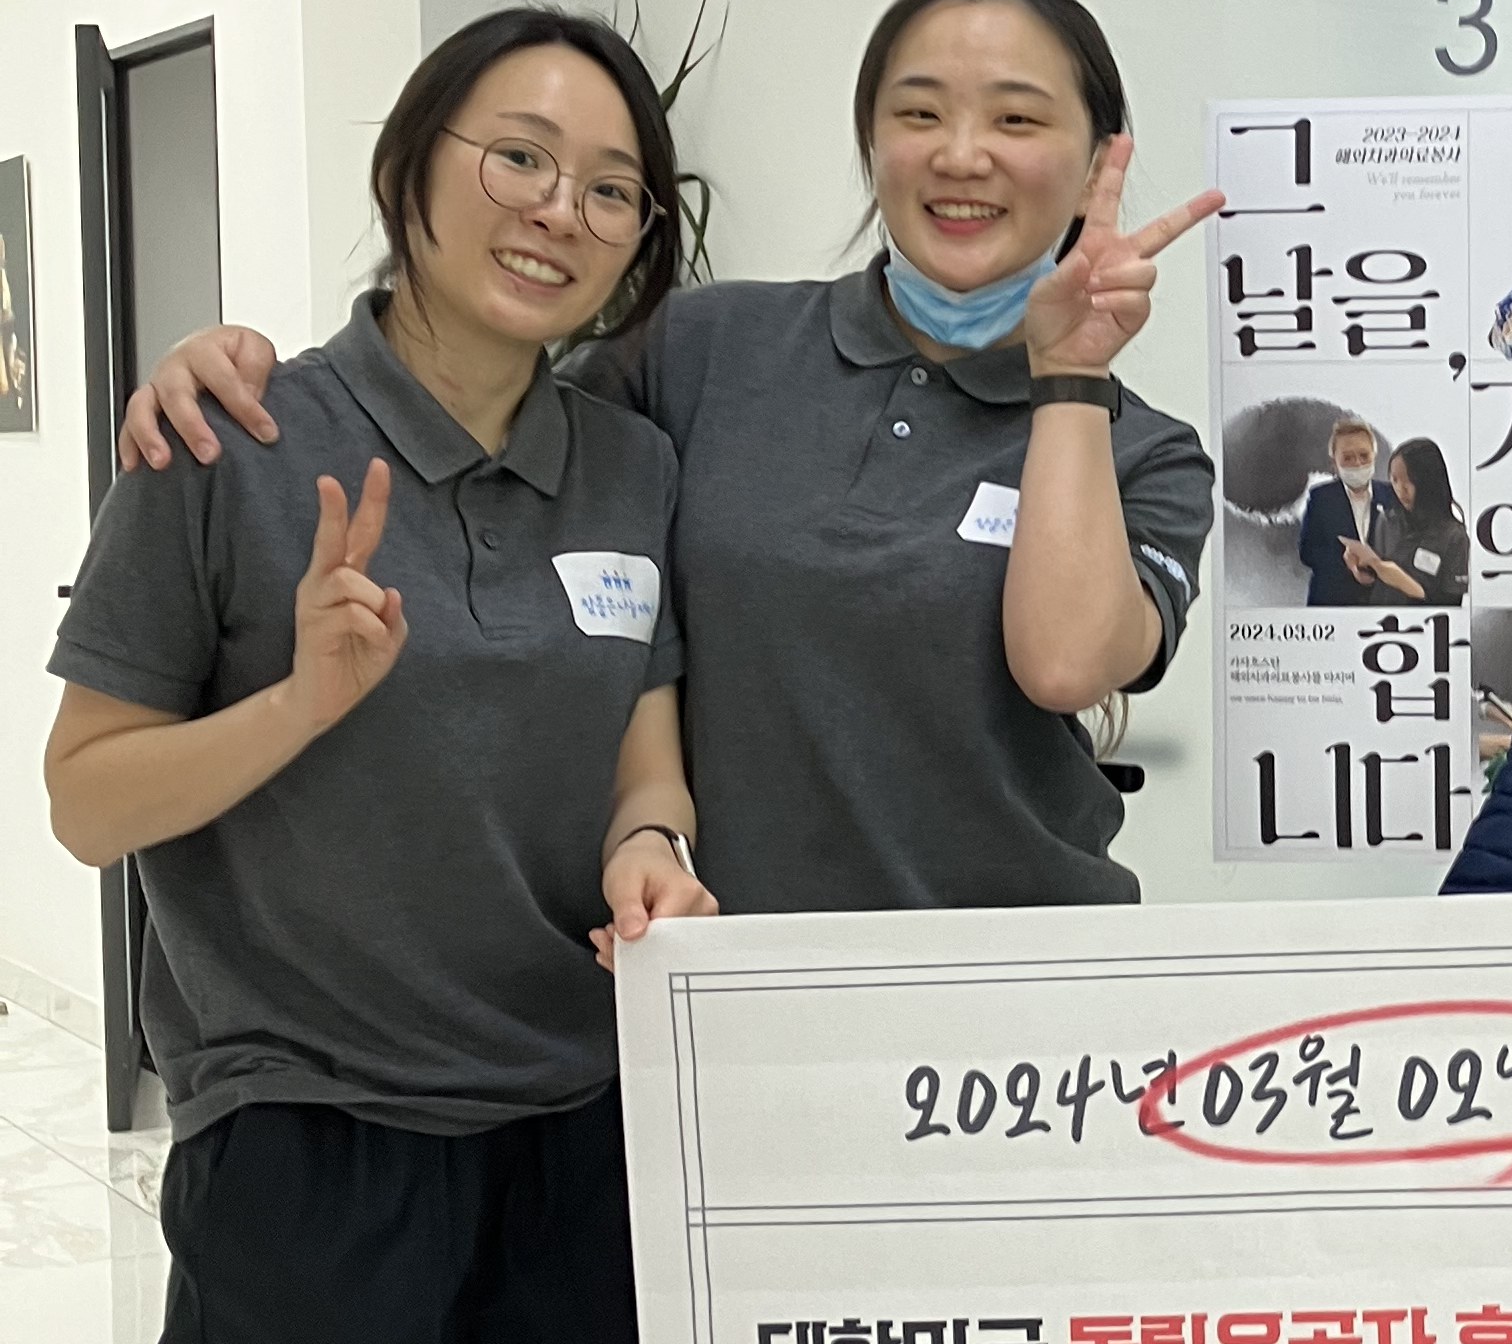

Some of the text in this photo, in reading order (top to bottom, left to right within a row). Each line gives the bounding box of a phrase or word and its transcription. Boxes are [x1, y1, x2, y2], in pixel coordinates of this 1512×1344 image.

[1217, 118, 1326, 219] 그
[1222, 244, 1466, 381] 날을,
[1229, 623, 1336, 641] 2024.03.02
[904, 1049, 1186, 1143] 2024년
[1202, 1034, 1374, 1141] 03월
